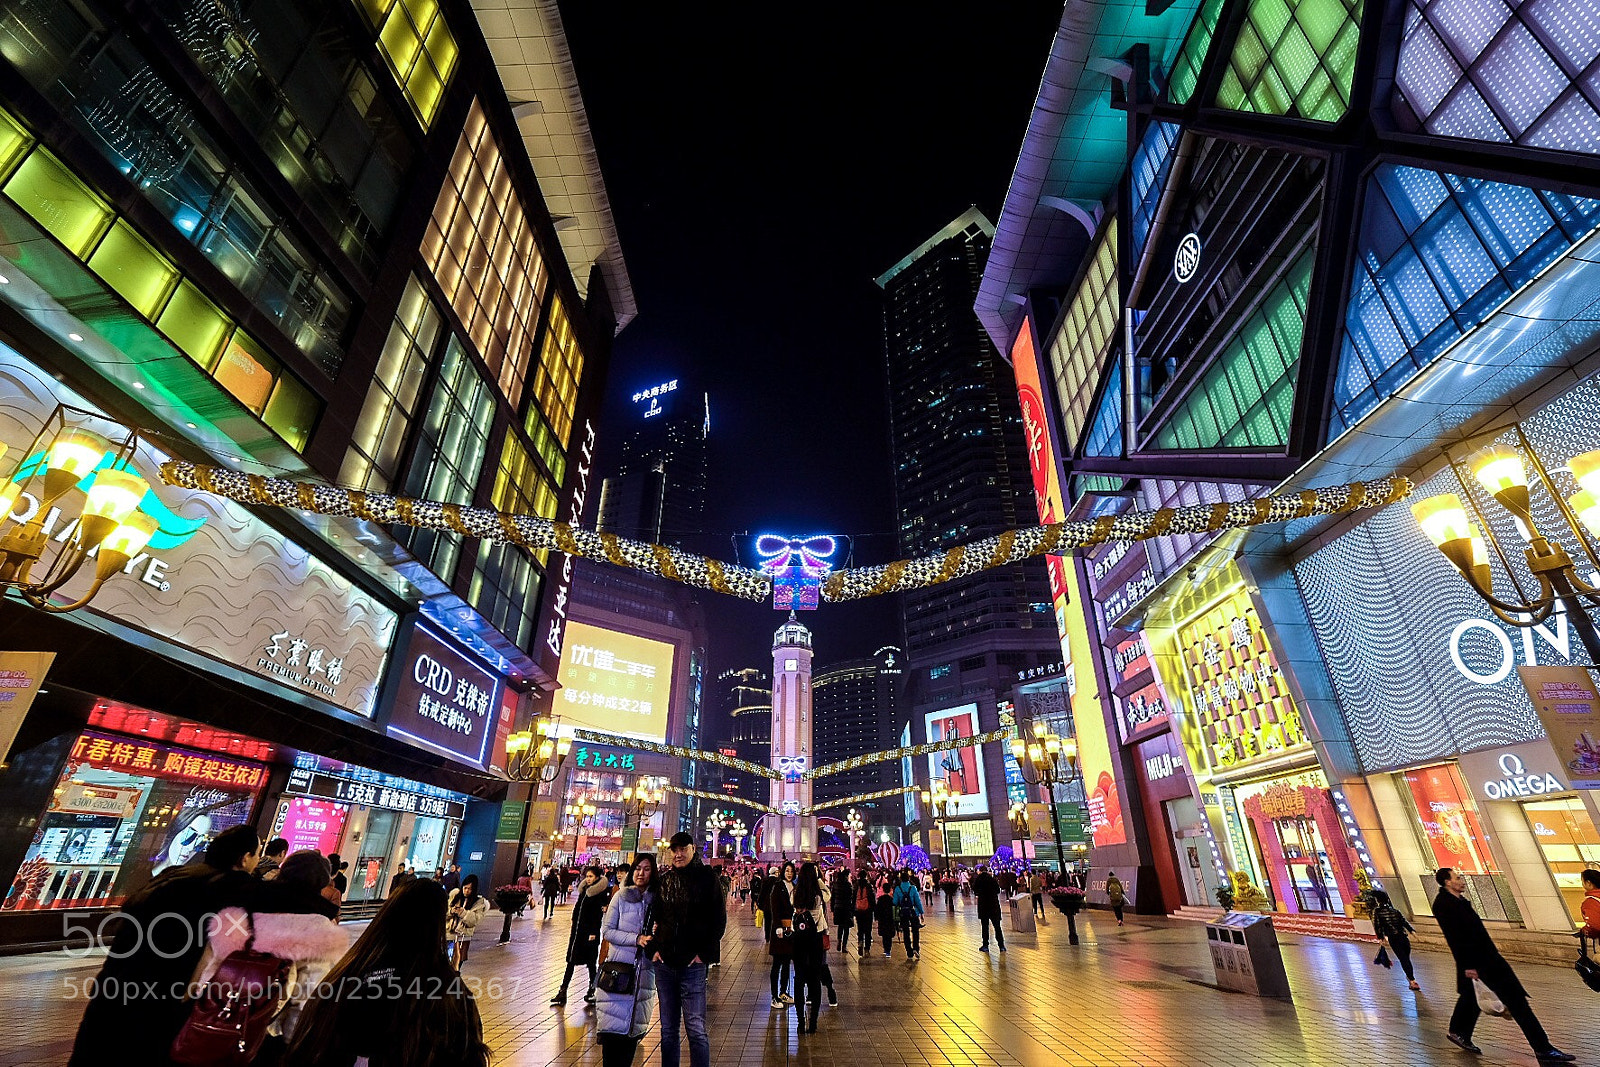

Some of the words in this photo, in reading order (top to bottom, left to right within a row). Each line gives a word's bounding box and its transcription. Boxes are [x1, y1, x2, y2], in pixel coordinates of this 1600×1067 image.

[257, 657, 302, 683] PREMIUM
[302, 678, 337, 698] OPTICAL
[414, 653, 452, 696] CRD
[1196, 661, 1284, 715] 财富购物中
[418, 692, 473, 736] 钻戒定制中心
[563, 687, 652, 715] 每分钟成交2辆
[1146, 753, 1173, 781] MUJI
[336, 781, 375, 804] 1.5克拉
[378, 788, 417, 811] 新款到店
[1484, 772, 1565, 801] OMEGA
[274, 802, 290, 832] CRD
[447, 826, 458, 856] CRD
